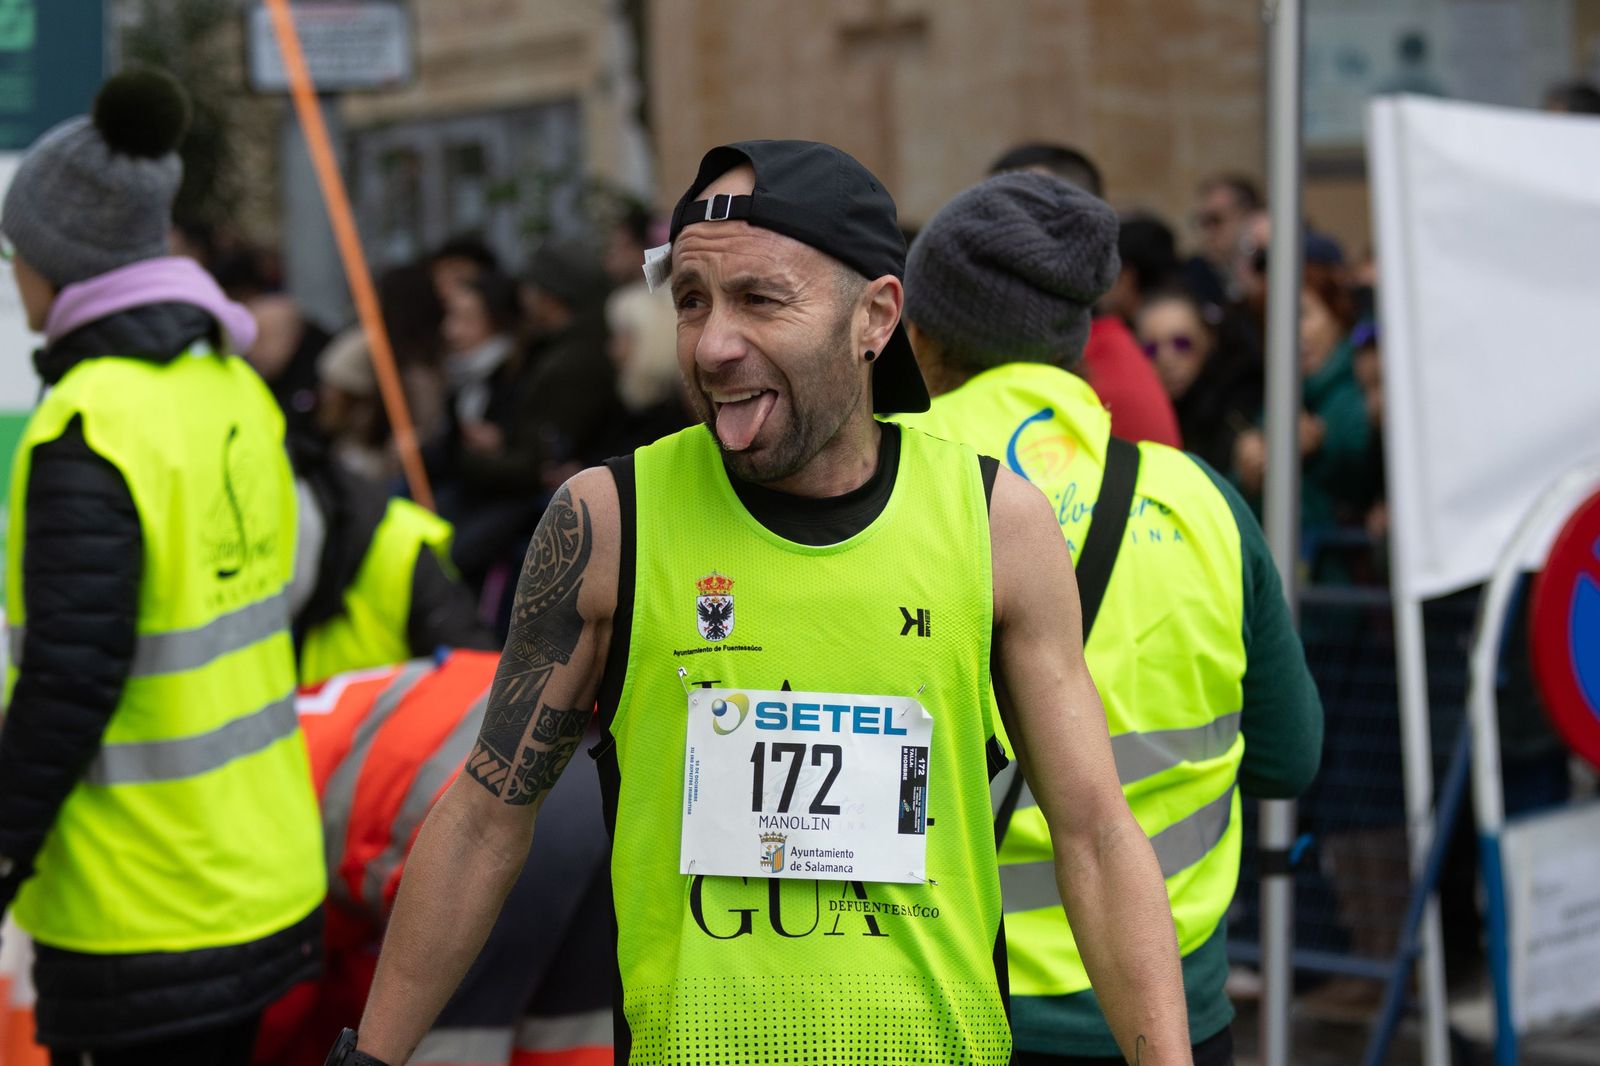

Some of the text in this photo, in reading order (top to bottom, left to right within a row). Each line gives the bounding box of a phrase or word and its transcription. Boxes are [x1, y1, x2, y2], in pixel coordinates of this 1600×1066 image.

[673, 645, 713, 656] Ayuntamiento
[754, 701, 907, 736] SETEL
[918, 757, 926, 776] 172
[750, 741, 843, 816] 172
[759, 815, 830, 831] MANOLIN
[790, 846, 854, 859] Ayuntamiento
[790, 860, 853, 873] de Salamanca
[690, 874, 890, 940] GUA
[829, 900, 940, 919] DEFUENTESAÚCO
